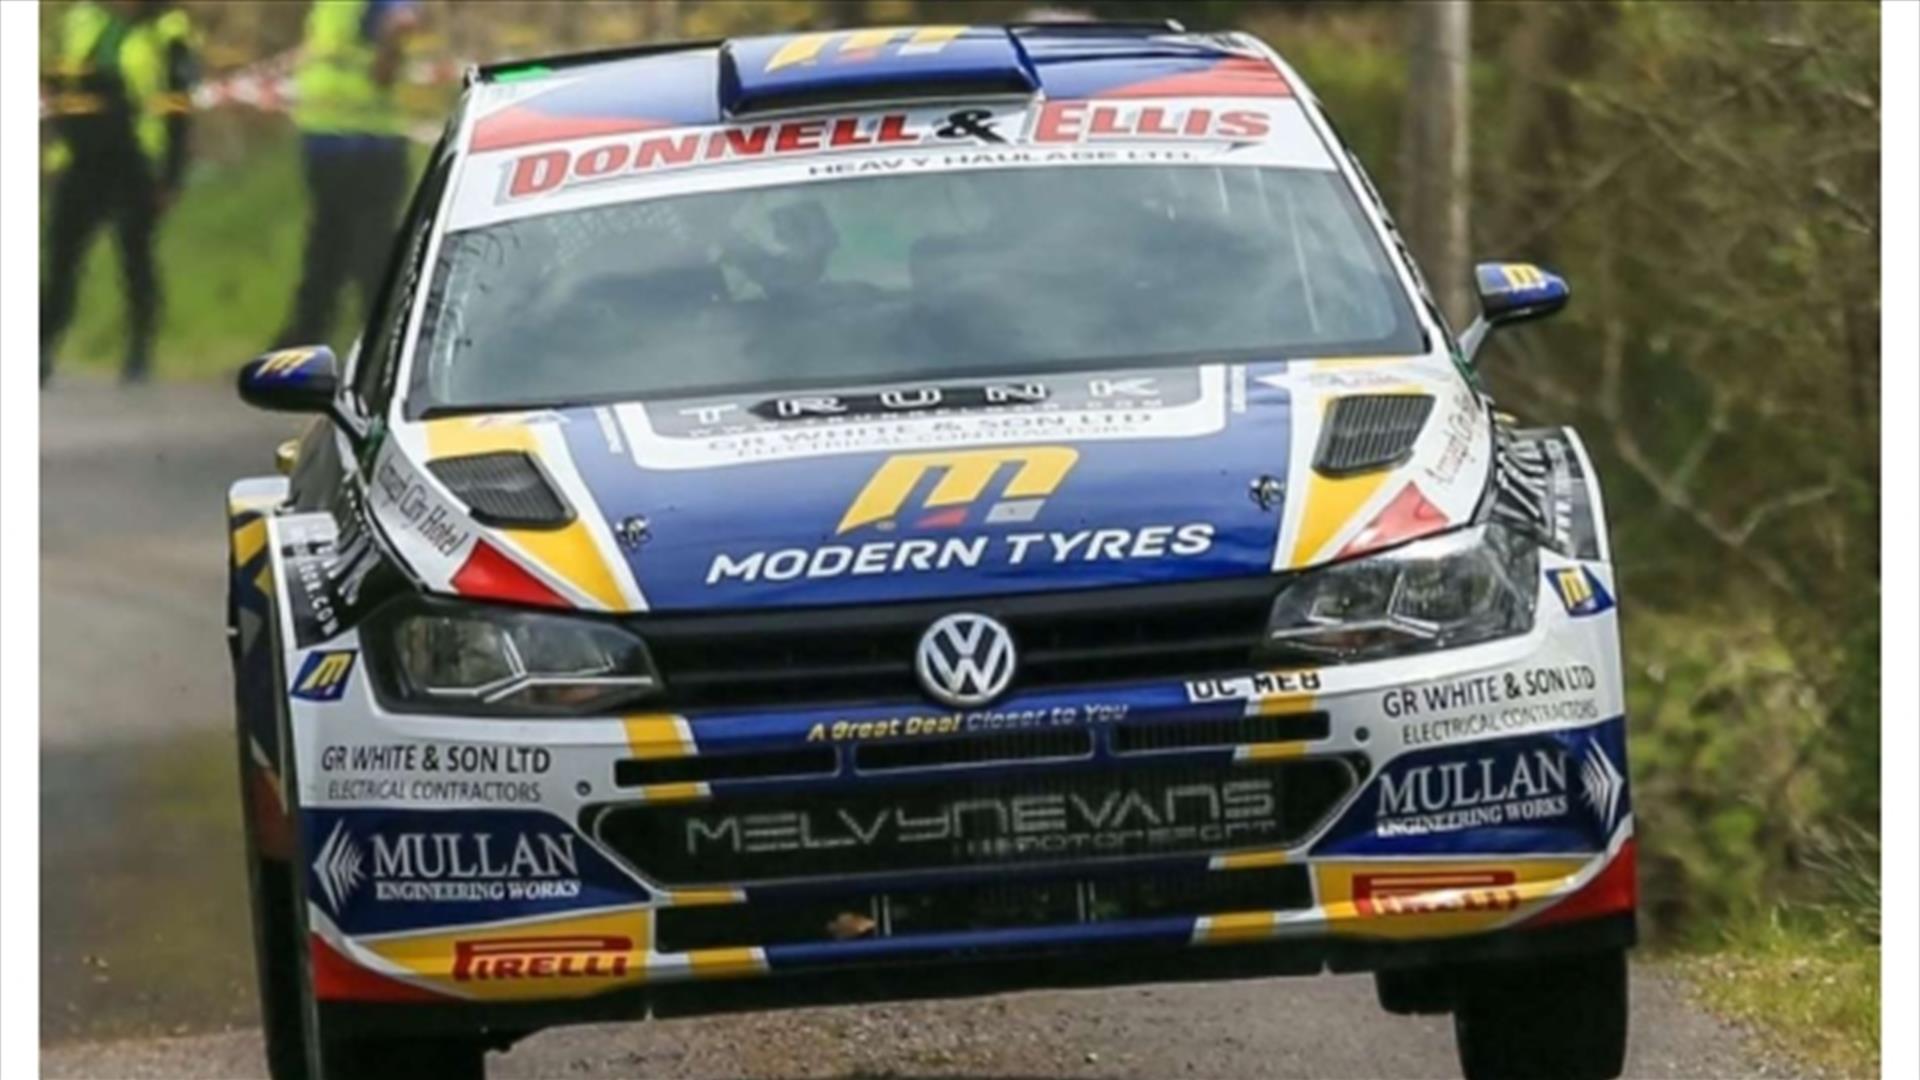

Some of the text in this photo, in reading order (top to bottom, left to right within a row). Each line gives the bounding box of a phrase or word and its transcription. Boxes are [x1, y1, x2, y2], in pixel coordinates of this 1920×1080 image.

[508, 98, 1271, 198] DONNELL & ELLIS
[809, 157, 930, 176] HEAVY
[943, 149, 1118, 168] HAULAGE
[679, 377, 1160, 425] TRUNK
[417, 502, 470, 558] Hotel
[706, 522, 1215, 585] MODERN TYRES
[1384, 664, 1596, 718] GR WHITE & SON LTD
[806, 723, 826, 742] A
[831, 715, 899, 739] Great
[1051, 706, 1078, 725] to
[1083, 703, 1128, 722] You
[1402, 713, 1496, 745] ELECTRICAL
[321, 744, 551, 774] GR WHITE & SON LTD
[328, 780, 541, 803] ELECTRICAL CONTRACTORS
[1376, 751, 1567, 817] MULLAN
[1376, 796, 1568, 838] ENGINEERING WORKS
[370, 832, 579, 880] MULLAN
[376, 879, 581, 901] ENGINEERING WORKS
[453, 935, 633, 983] PIRELLI
